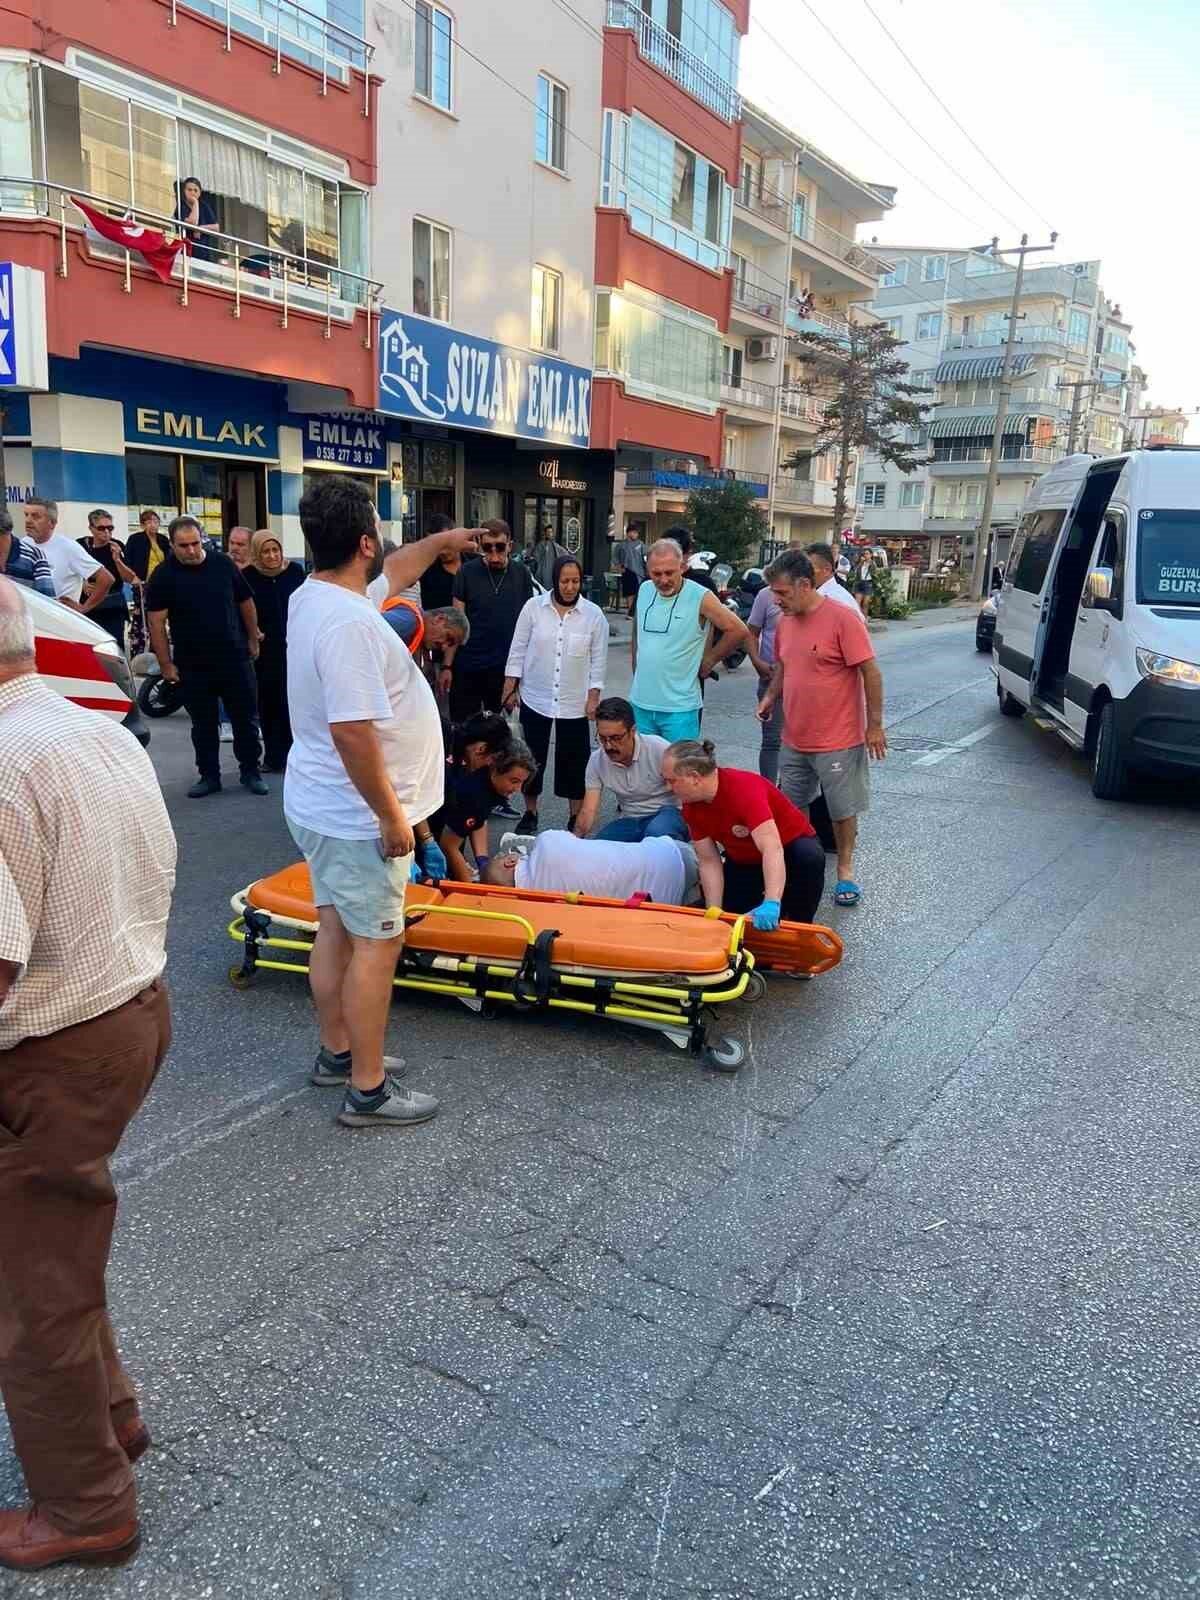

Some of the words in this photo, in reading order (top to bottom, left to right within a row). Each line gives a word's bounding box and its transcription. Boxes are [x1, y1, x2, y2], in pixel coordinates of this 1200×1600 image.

[447, 342, 520, 425] SUZAN
[527, 364, 590, 437] EMLAK
[137, 407, 267, 448] EMLAK
[308, 420, 382, 449] EMLAK
[1158, 578, 1200, 593] BUR
